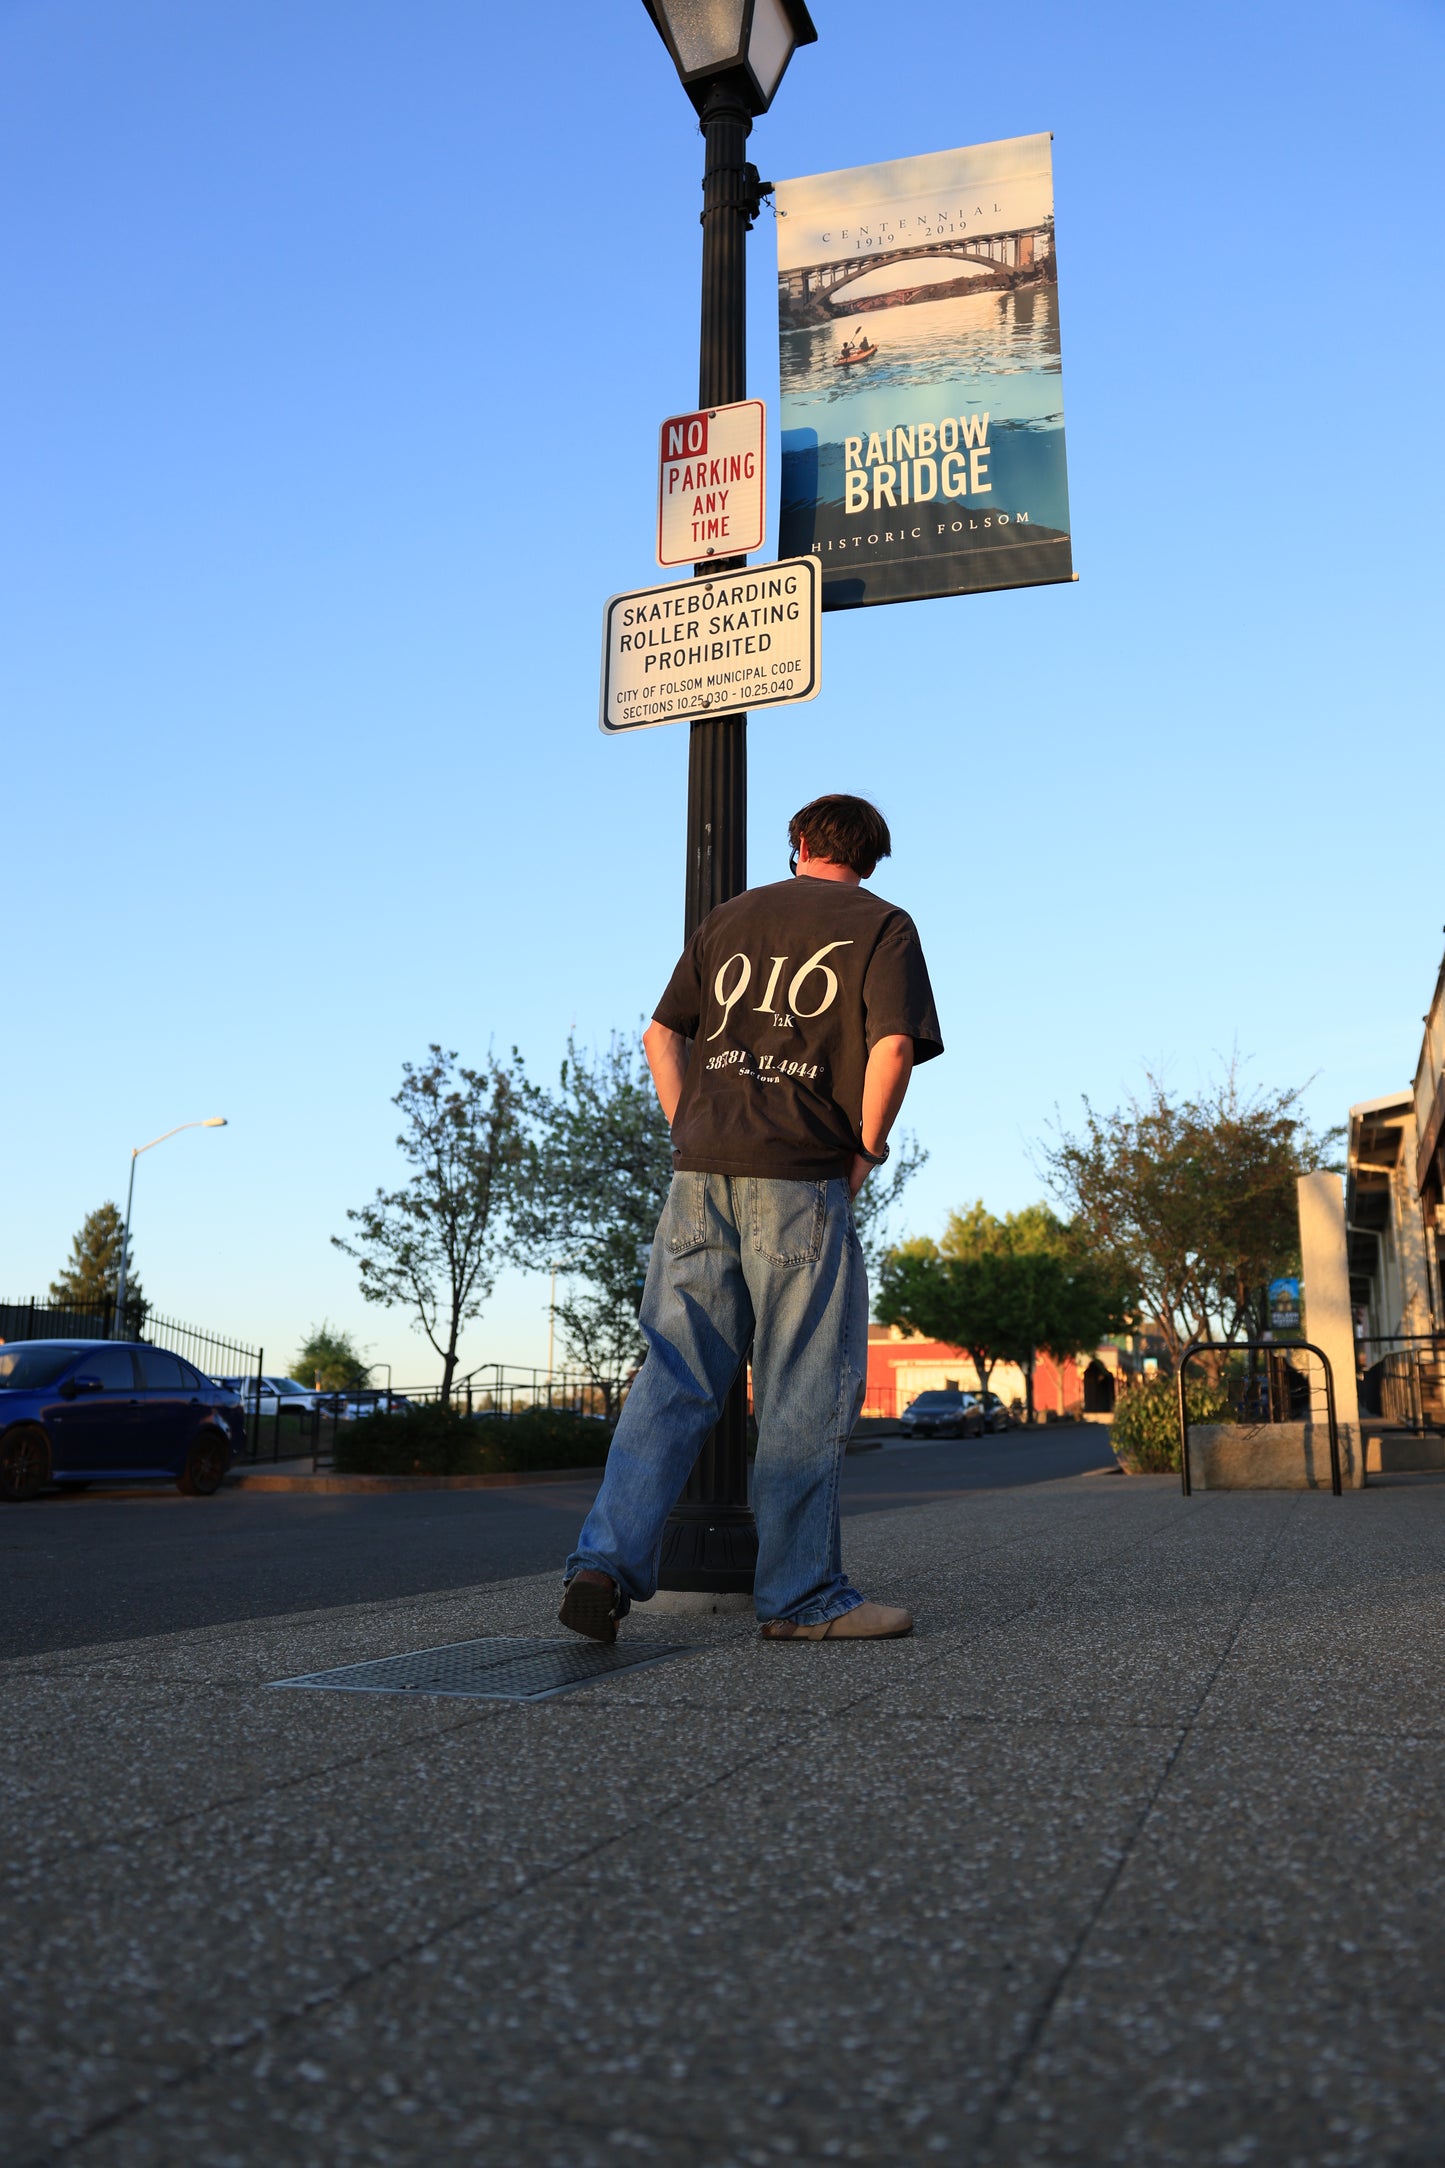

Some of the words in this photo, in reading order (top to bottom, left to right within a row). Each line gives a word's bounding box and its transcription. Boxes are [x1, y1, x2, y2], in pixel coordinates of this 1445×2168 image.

[821, 203, 1002, 243] CENTENNIAL
[855, 234, 895, 250] 1919
[925, 221, 967, 237] 2019
[668, 420, 704, 457] NO
[844, 412, 990, 471] RAINBOW
[668, 452, 755, 495] PARKING
[844, 447, 993, 515] BRIDGE
[692, 490, 730, 517] ANY
[691, 516, 730, 542] TIME
[811, 527, 921, 553] HISTORIC
[937, 511, 1030, 535] FOLSOM
[622, 576, 798, 628] SKATEBOARDING
[620, 621, 699, 653] ROLLER
[708, 601, 800, 636] SKATING
[644, 633, 772, 674] PROHIBITED
[616, 688, 639, 704] CITY
[642, 685, 657, 699] OF
[660, 677, 703, 696] FOLSOM
[707, 668, 767, 688] MUNICIPAL
[771, 659, 802, 676] CODE
[622, 700, 673, 719] SECTIONS
[677, 690, 729, 710] 10.25030
[740, 678, 794, 698] 10.25.040
[706, 940, 854, 1042] 916
[772, 1013, 796, 1028] Y2K
